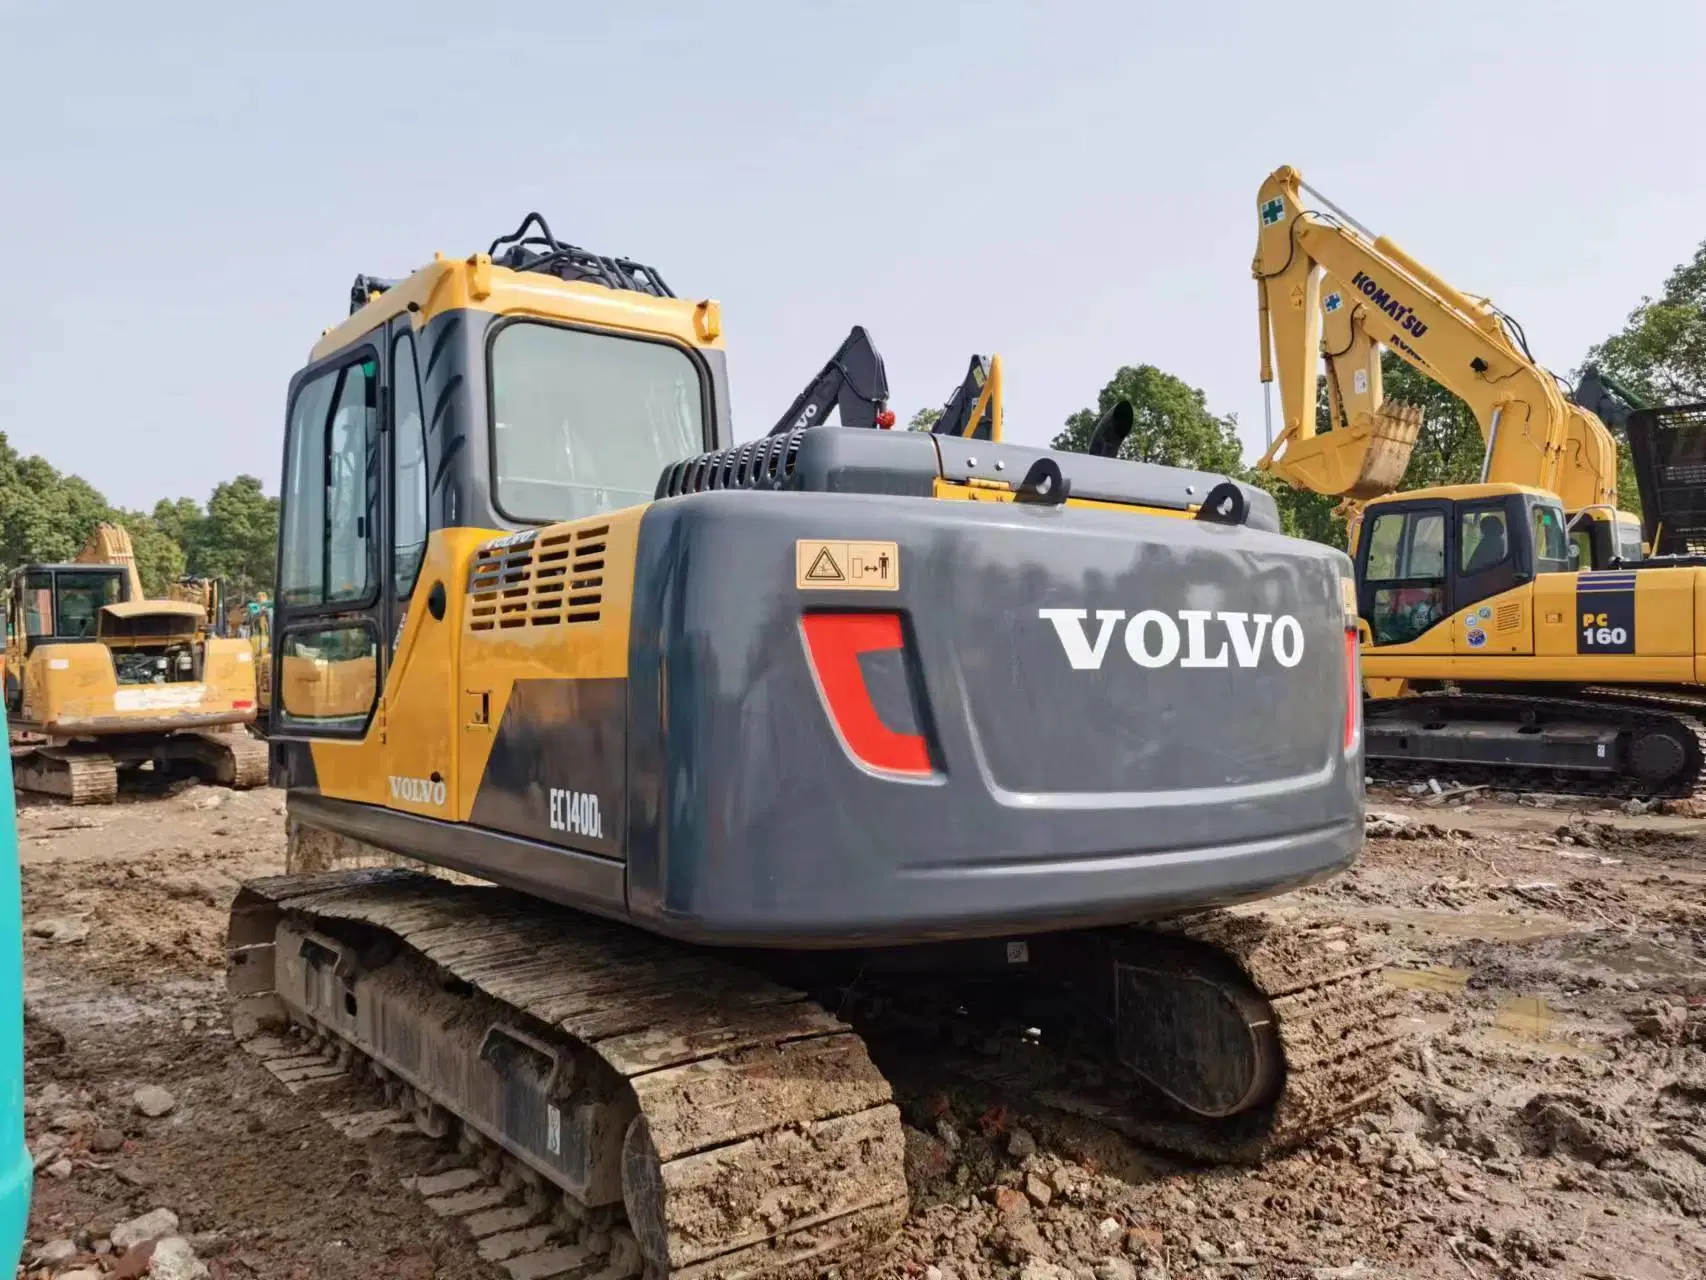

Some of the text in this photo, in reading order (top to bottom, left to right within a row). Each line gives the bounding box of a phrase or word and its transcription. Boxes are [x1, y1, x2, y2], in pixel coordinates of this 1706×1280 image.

[1352, 271, 1428, 338] KOMATSU
[1583, 613, 1608, 627] PC
[1038, 608, 1305, 670] VOLVO
[1583, 627, 1627, 645] 160
[388, 776, 447, 805] VOLVO
